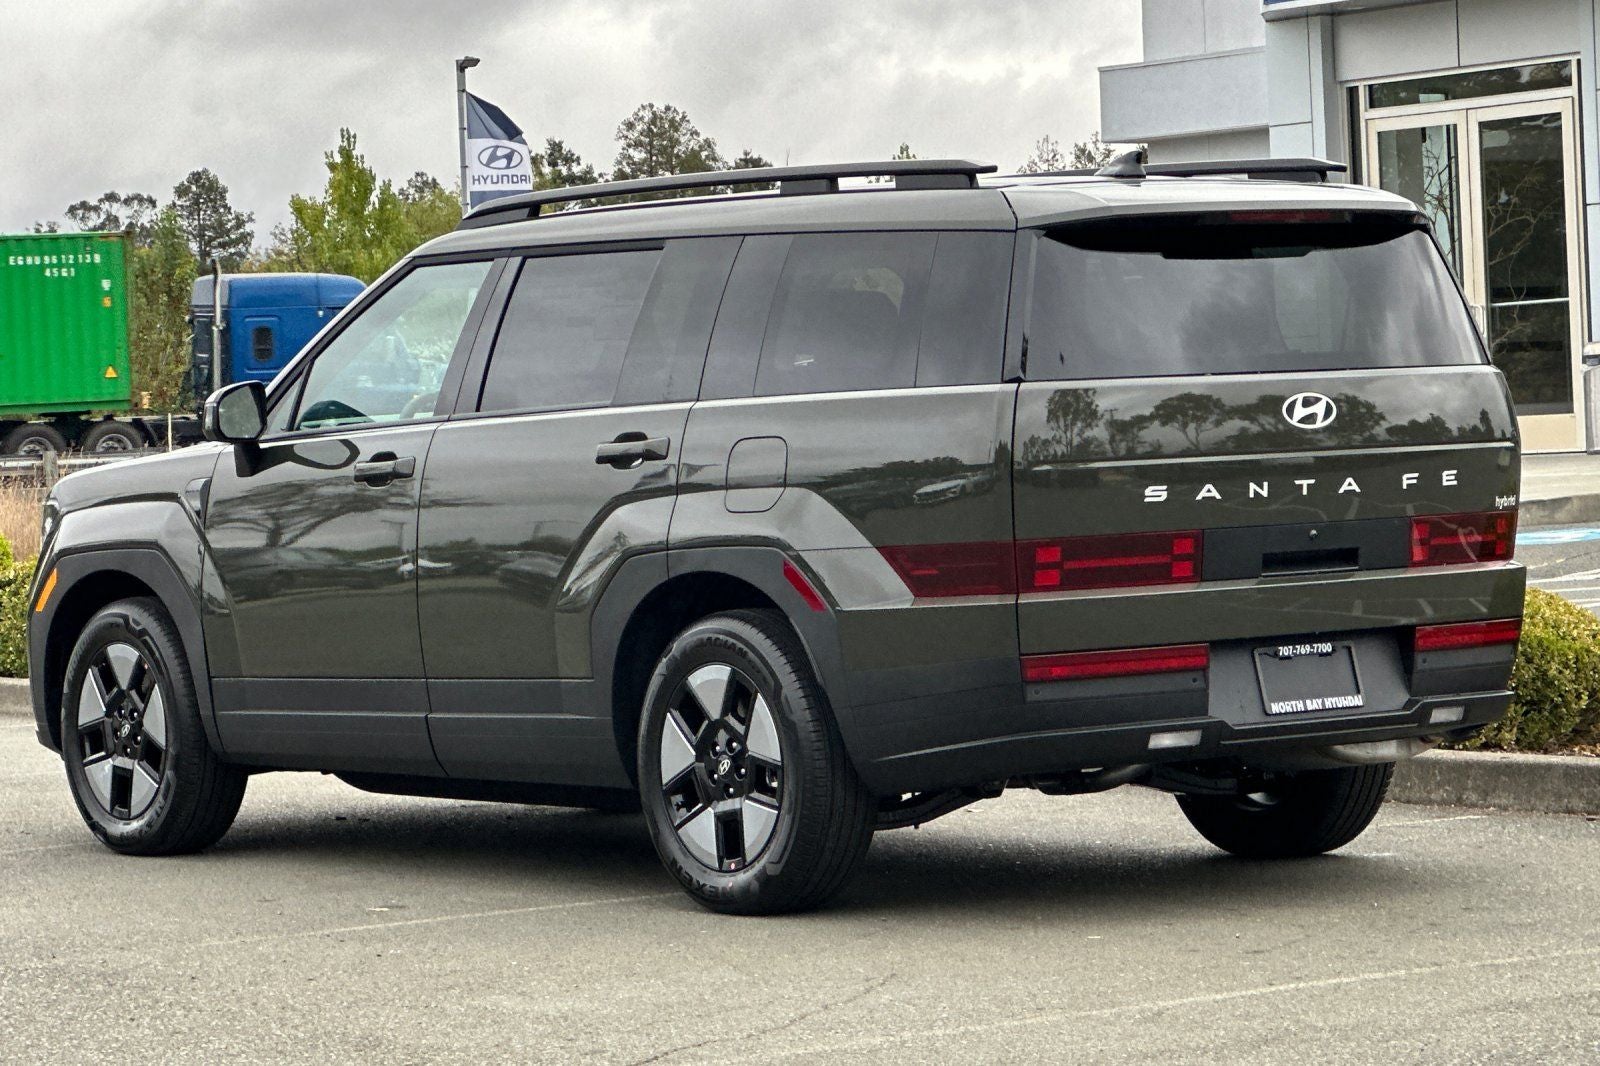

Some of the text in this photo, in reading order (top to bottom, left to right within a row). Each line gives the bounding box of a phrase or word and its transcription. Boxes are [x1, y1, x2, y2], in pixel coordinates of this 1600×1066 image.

[473, 174, 531, 185] HYUNDAI
[1143, 470, 1458, 502] SANTA FE
[1495, 494, 1516, 509] hybrid
[1278, 642, 1332, 656] 707-769-7700
[1271, 694, 1363, 713] NORTH BAY HYUNDAI
